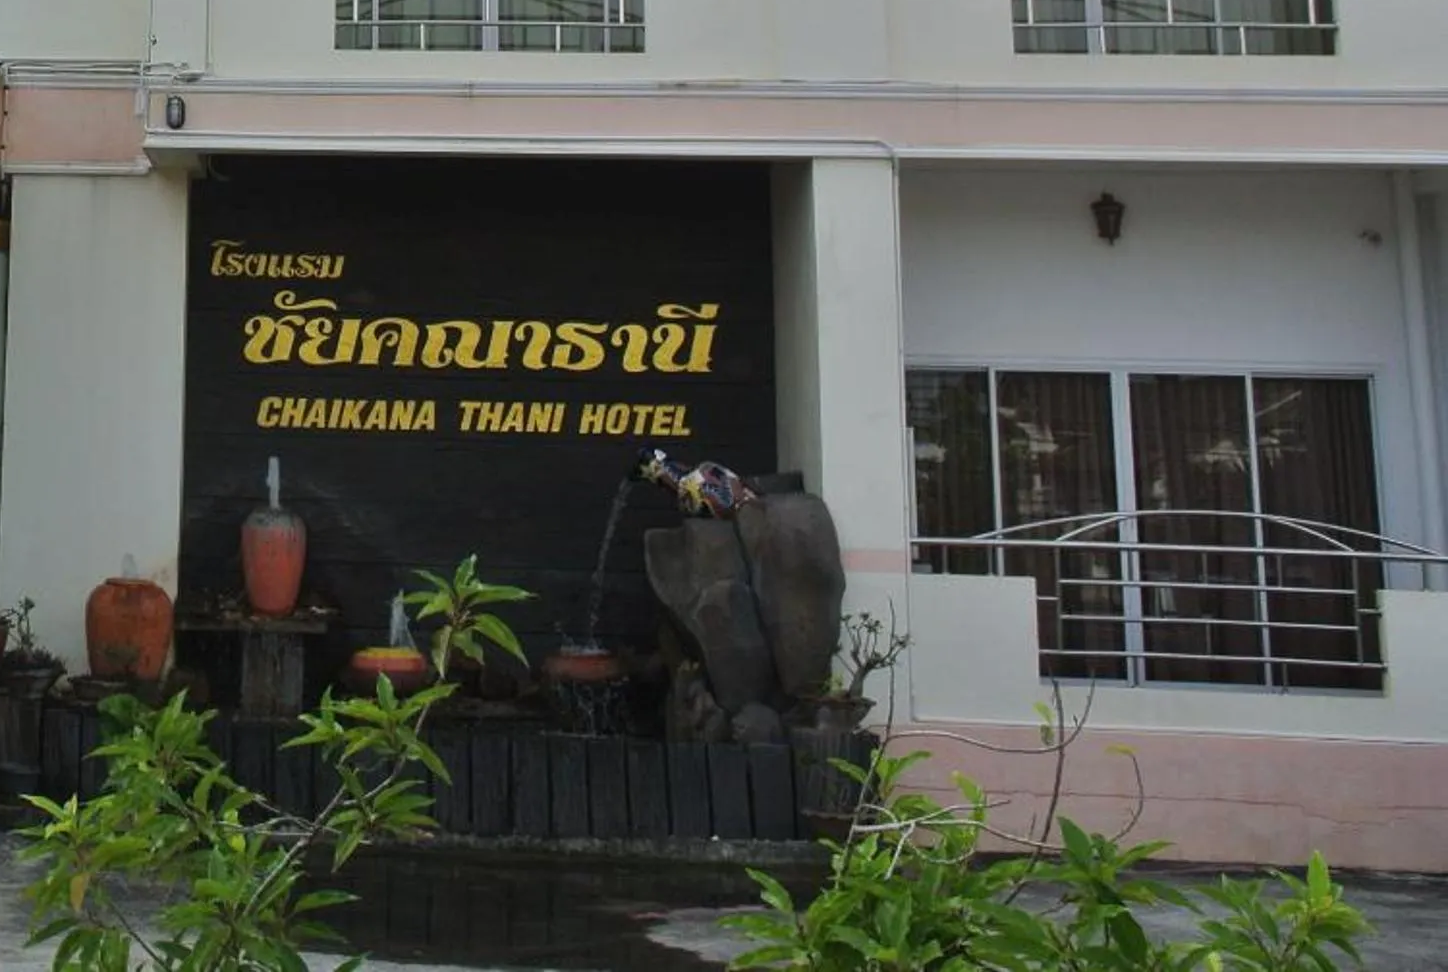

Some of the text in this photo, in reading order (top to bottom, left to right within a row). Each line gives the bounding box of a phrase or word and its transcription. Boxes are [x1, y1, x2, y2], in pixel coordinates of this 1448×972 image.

[209, 240, 346, 279] โรงแรม
[257, 397, 692, 437] CHAIKANA THANI HOTEL
